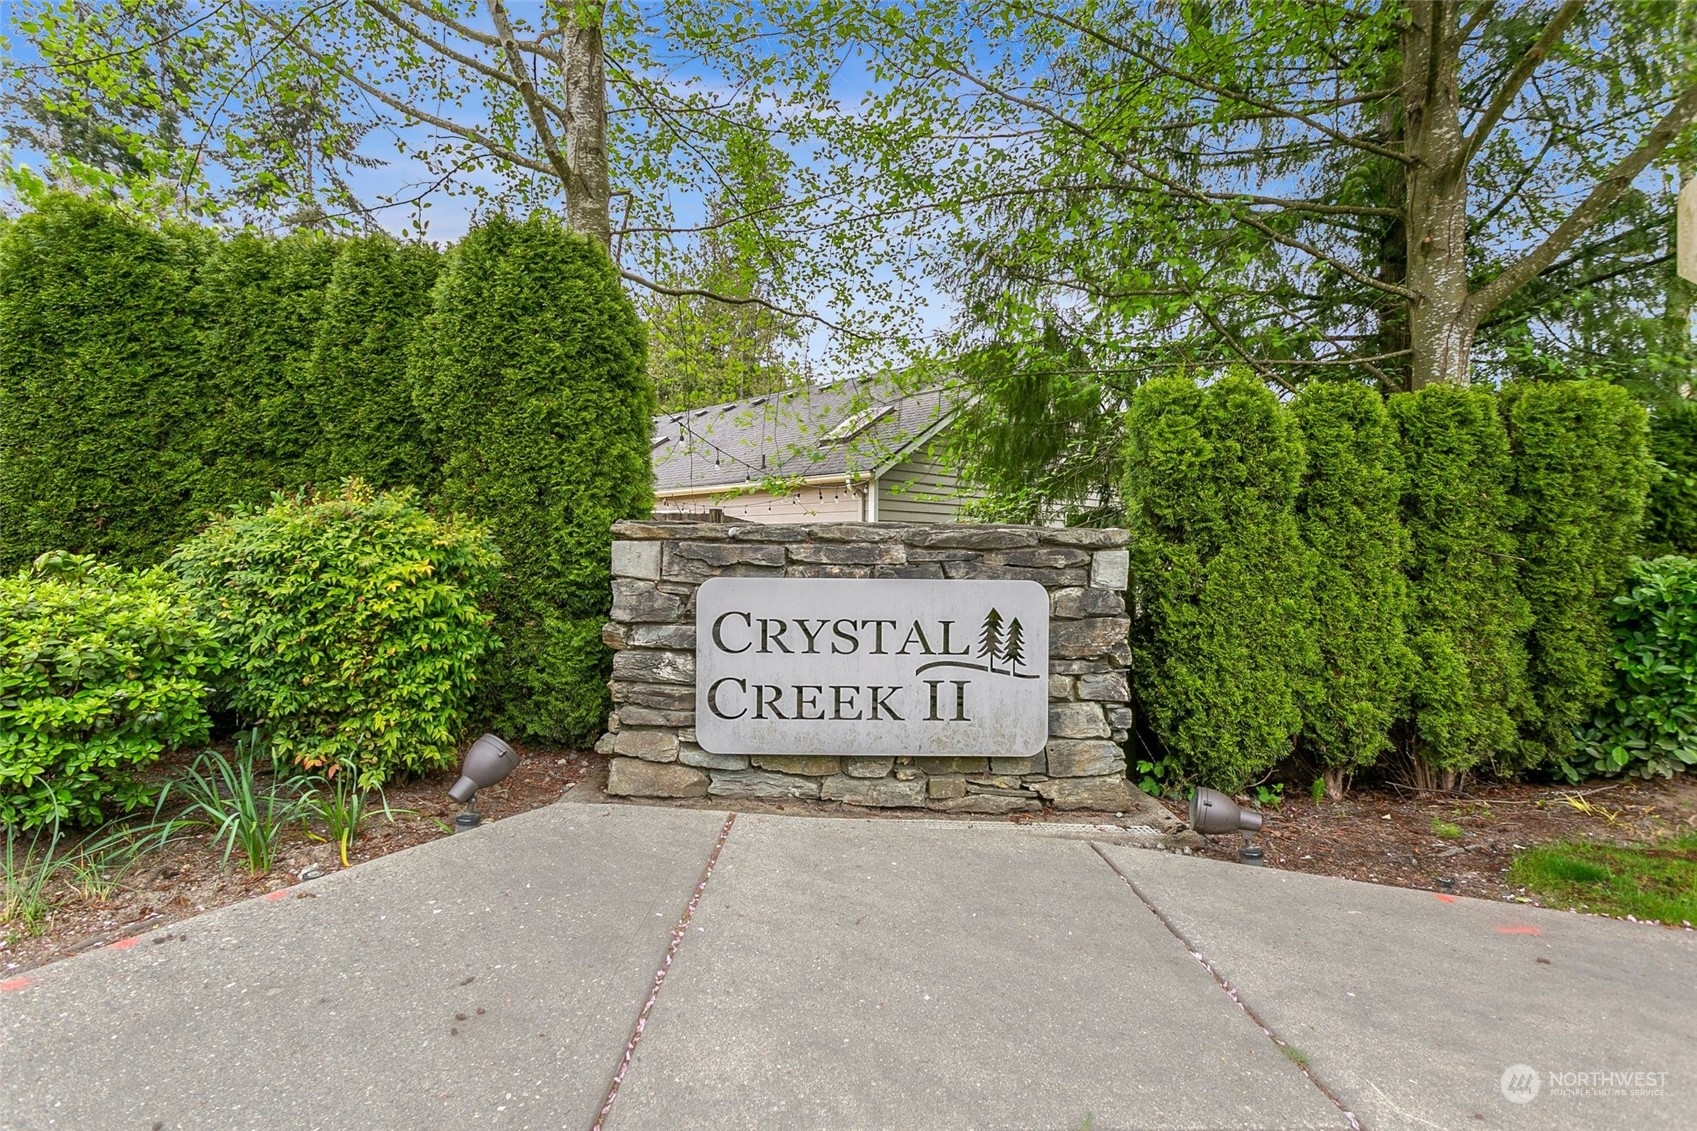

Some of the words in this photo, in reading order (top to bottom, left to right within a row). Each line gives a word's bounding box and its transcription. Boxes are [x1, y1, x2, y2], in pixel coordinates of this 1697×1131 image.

[711, 611, 970, 655] CRYSTAL
[706, 677, 905, 721] CREEK
[922, 679, 972, 722] II
